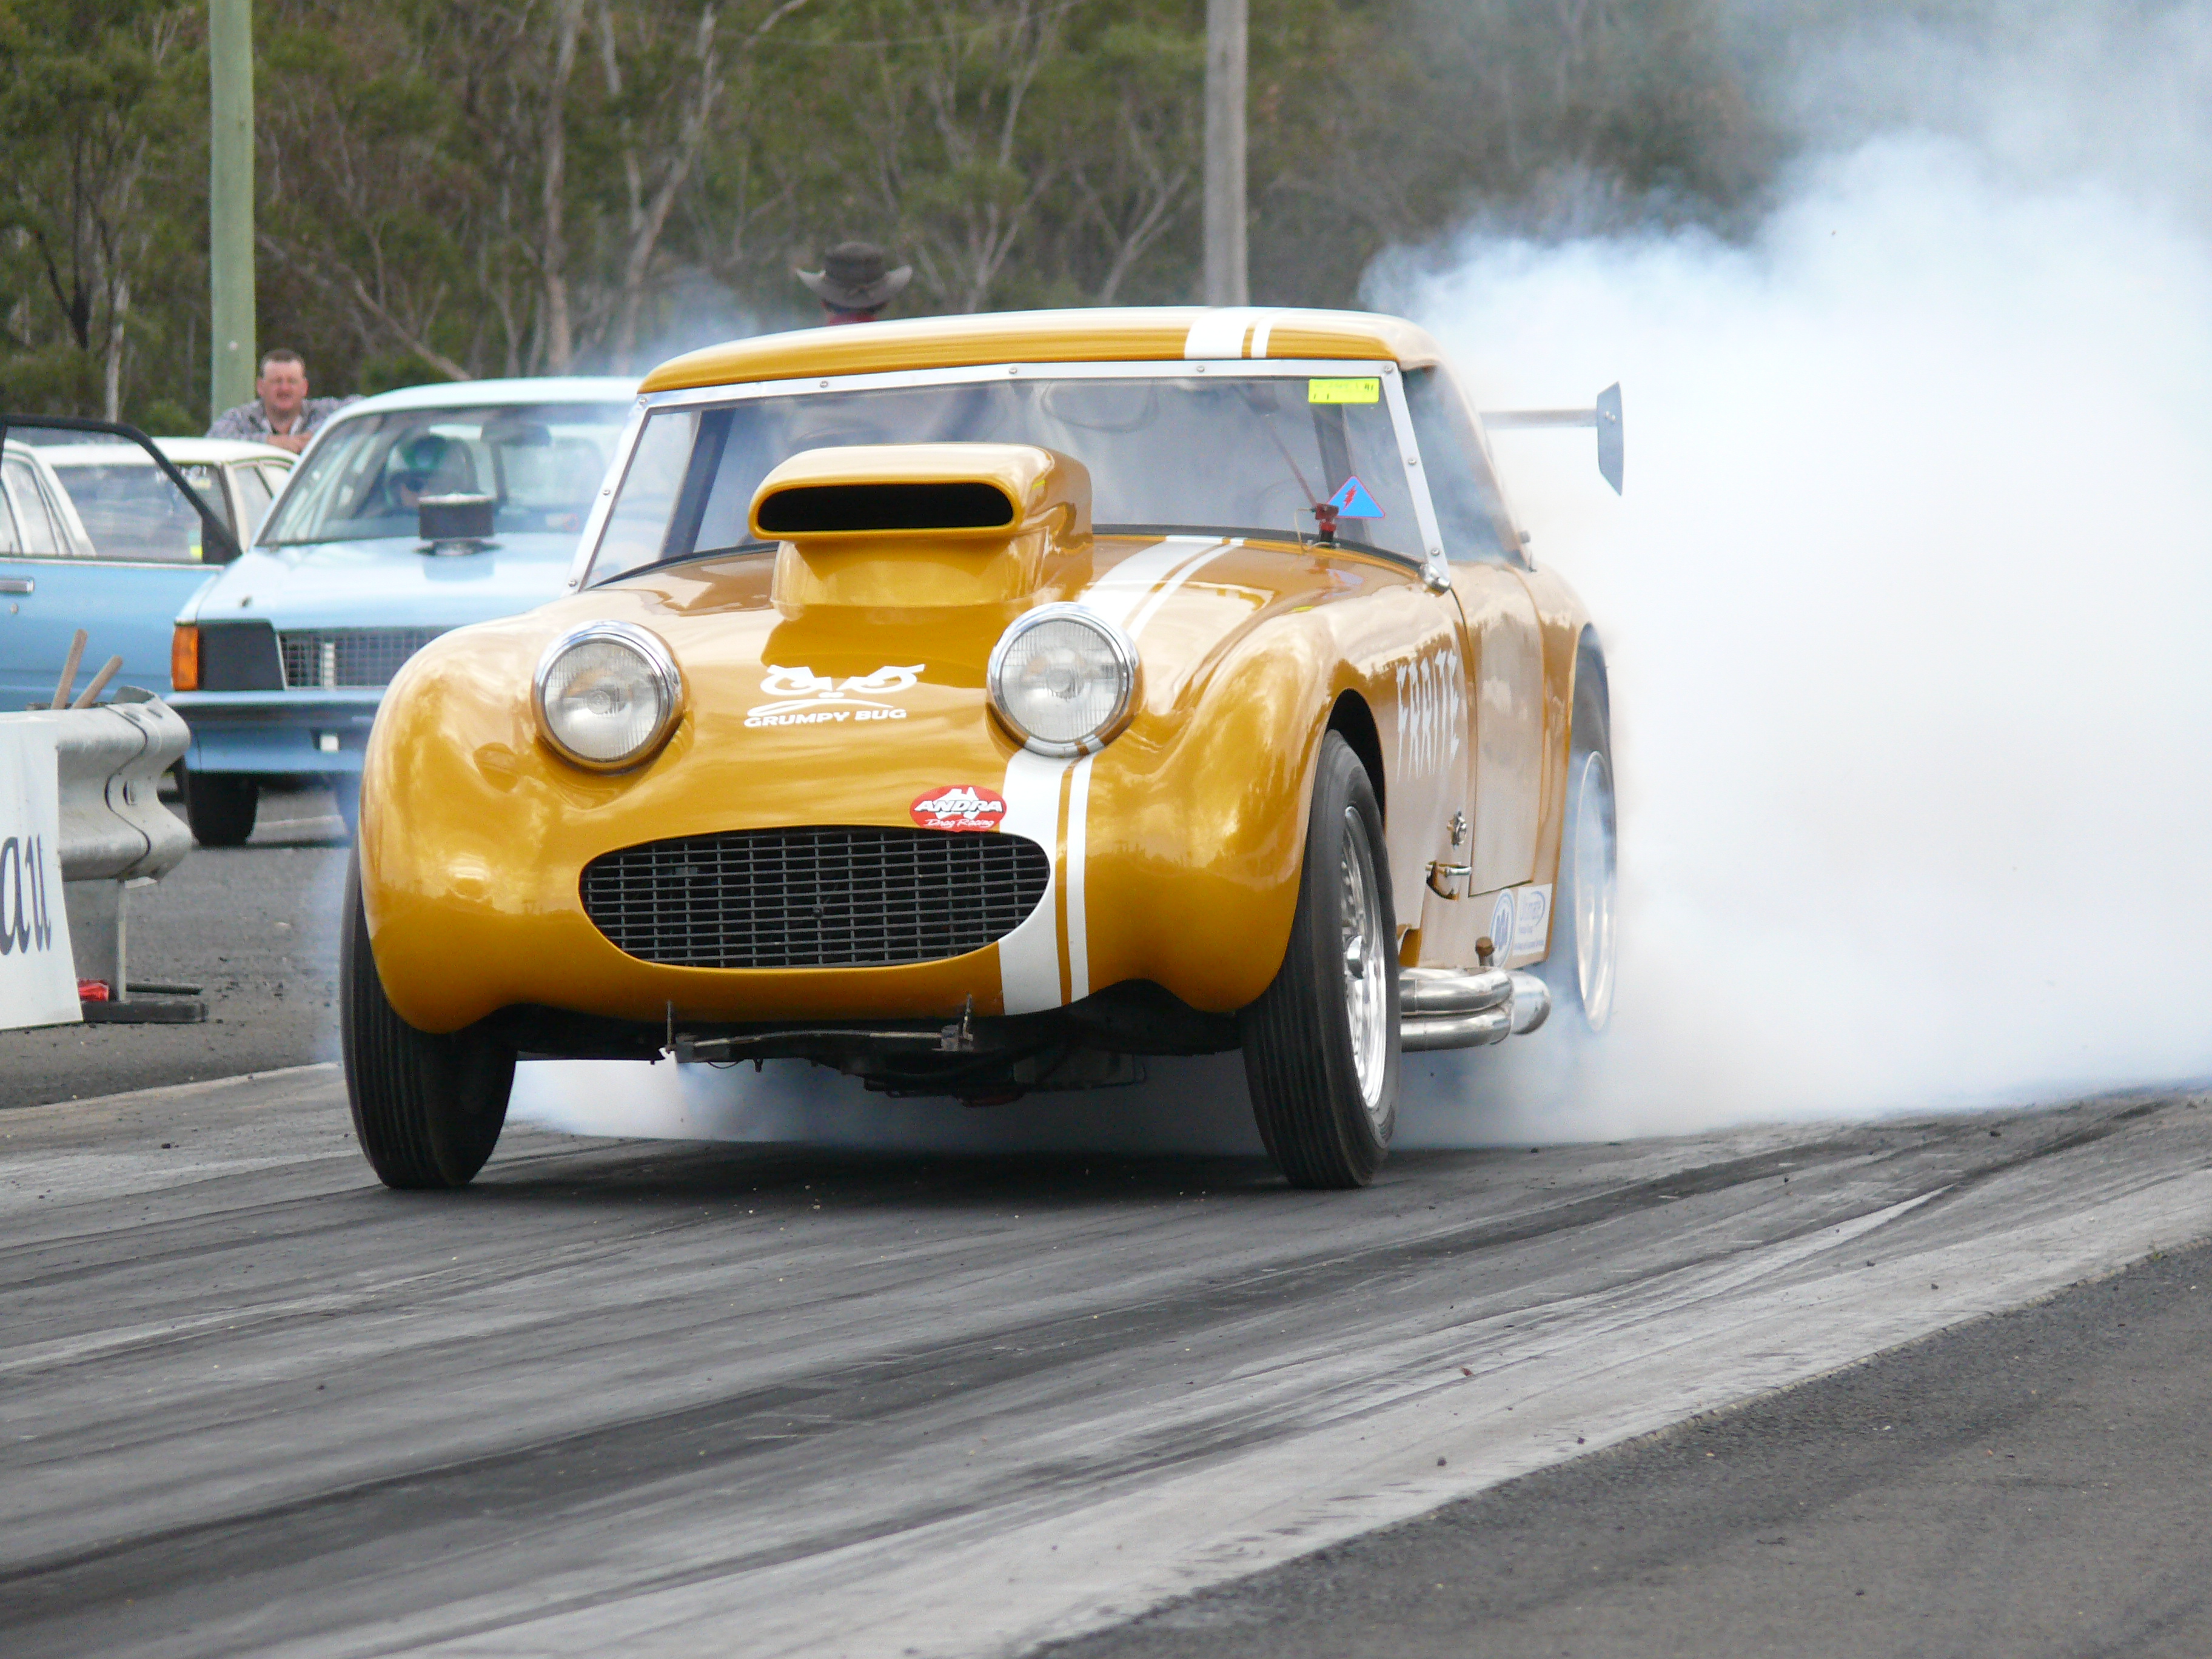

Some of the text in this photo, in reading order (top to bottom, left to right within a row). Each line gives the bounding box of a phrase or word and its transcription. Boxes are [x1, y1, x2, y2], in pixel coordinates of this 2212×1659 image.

[743, 708, 907, 727] GRUMPY BUG
[914, 800, 1004, 813] ANDRA
[924, 819, 994, 829] Drag Racing
